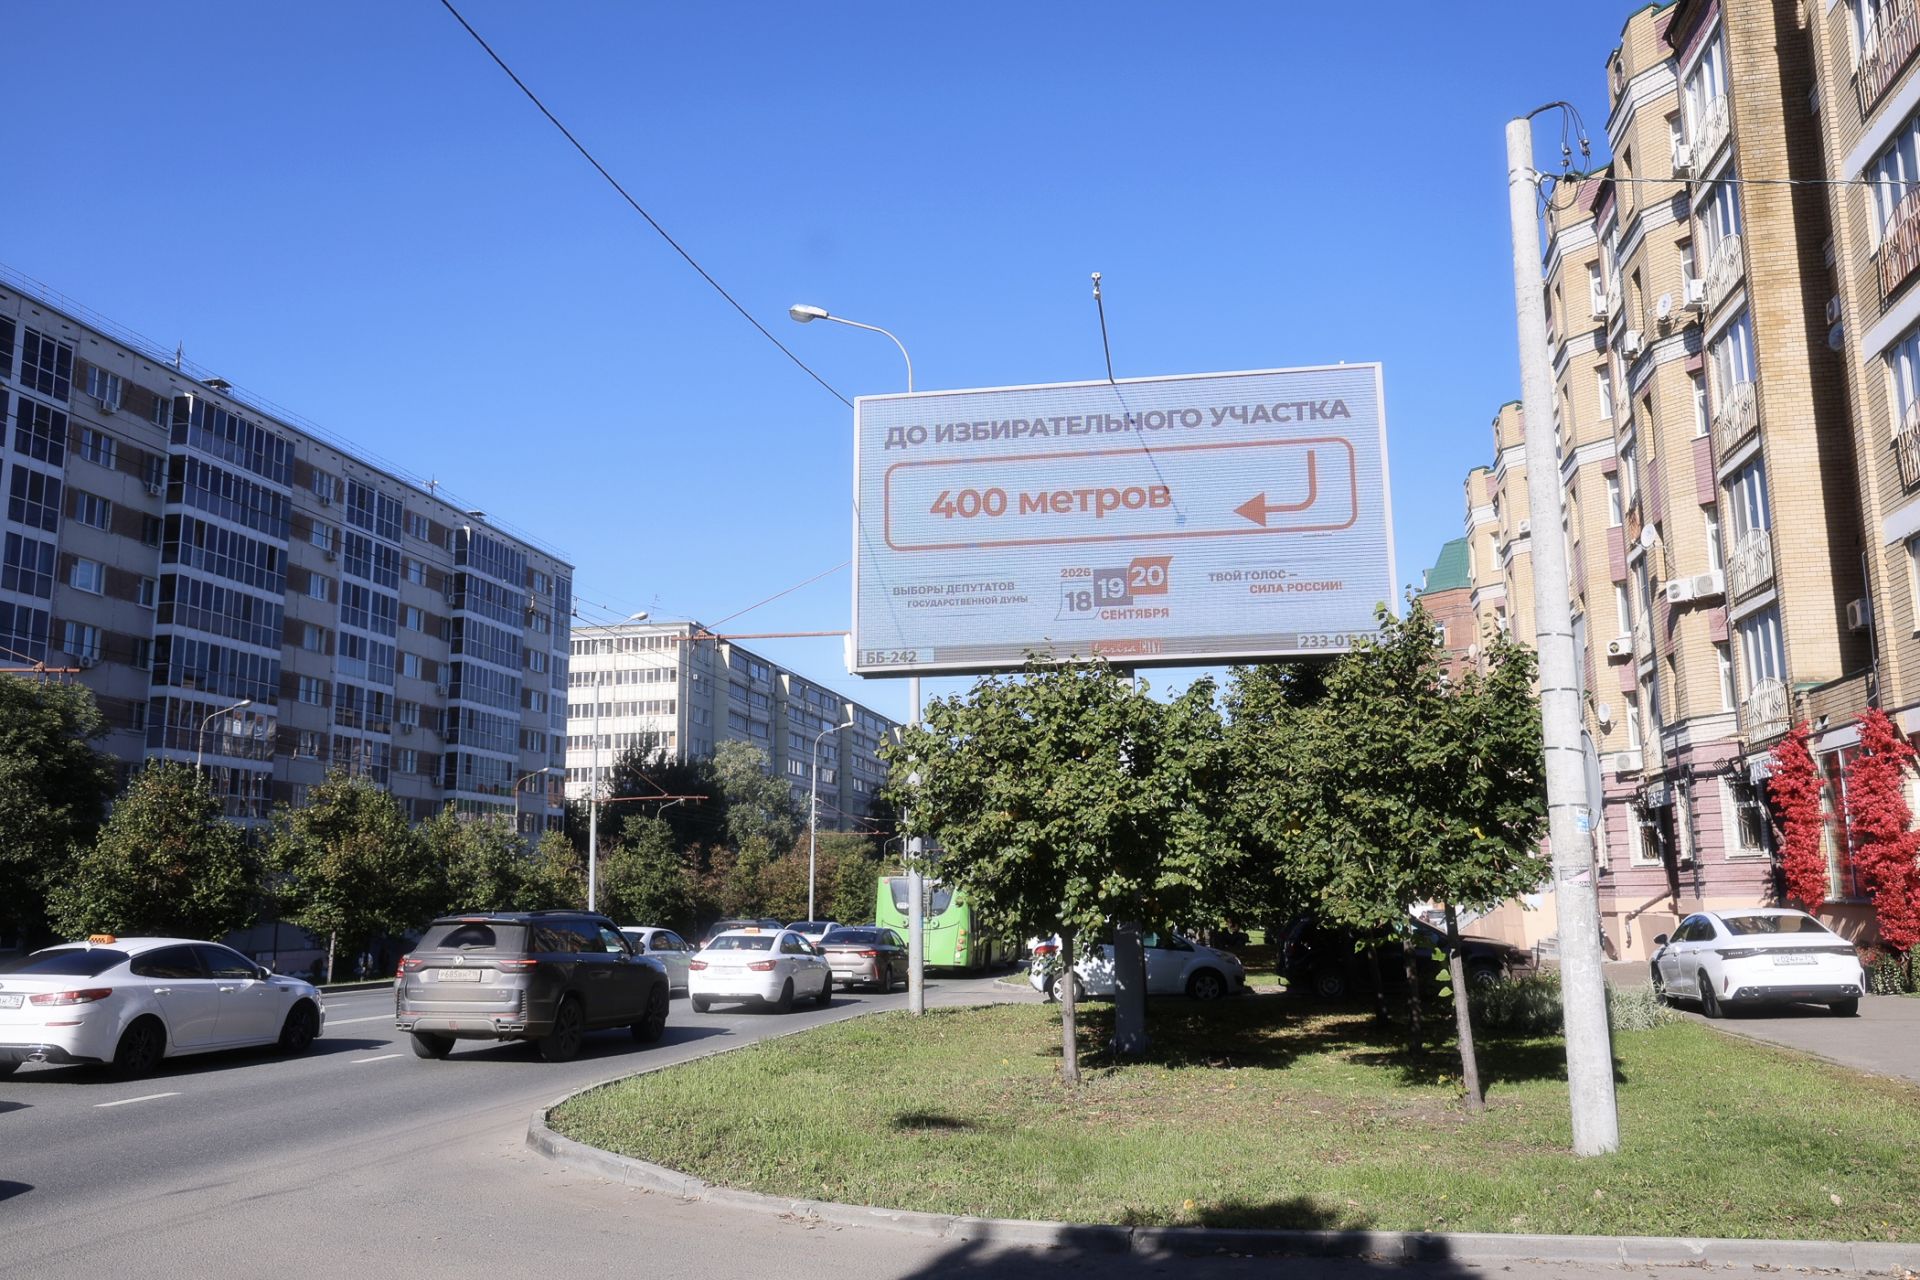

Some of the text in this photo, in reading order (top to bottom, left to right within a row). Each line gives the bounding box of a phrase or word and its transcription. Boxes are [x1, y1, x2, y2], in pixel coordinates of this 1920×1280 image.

[884, 399, 1351, 450] ДО ИЗБИРАТЕЛЬНОГО УЧАСТКА
[929, 485, 1172, 519] 400 метров
[1060, 567, 1091, 577] 2026
[1208, 570, 1242, 582] ТВОЙ
[1245, 569, 1286, 580] ГОЛОС
[892, 581, 1015, 596] ВЫБОРЫ ДЕПУТАТОВ
[1065, 565, 1165, 612] 18 19 20
[1249, 580, 1343, 594] СИЛА РОССИИ!
[907, 595, 1029, 608] ГОСУДАРСТВЕННОЙ ДУМЫ
[1100, 607, 1170, 620] СЕНТЯБРЯ
[866, 650, 917, 664] ББ-242
